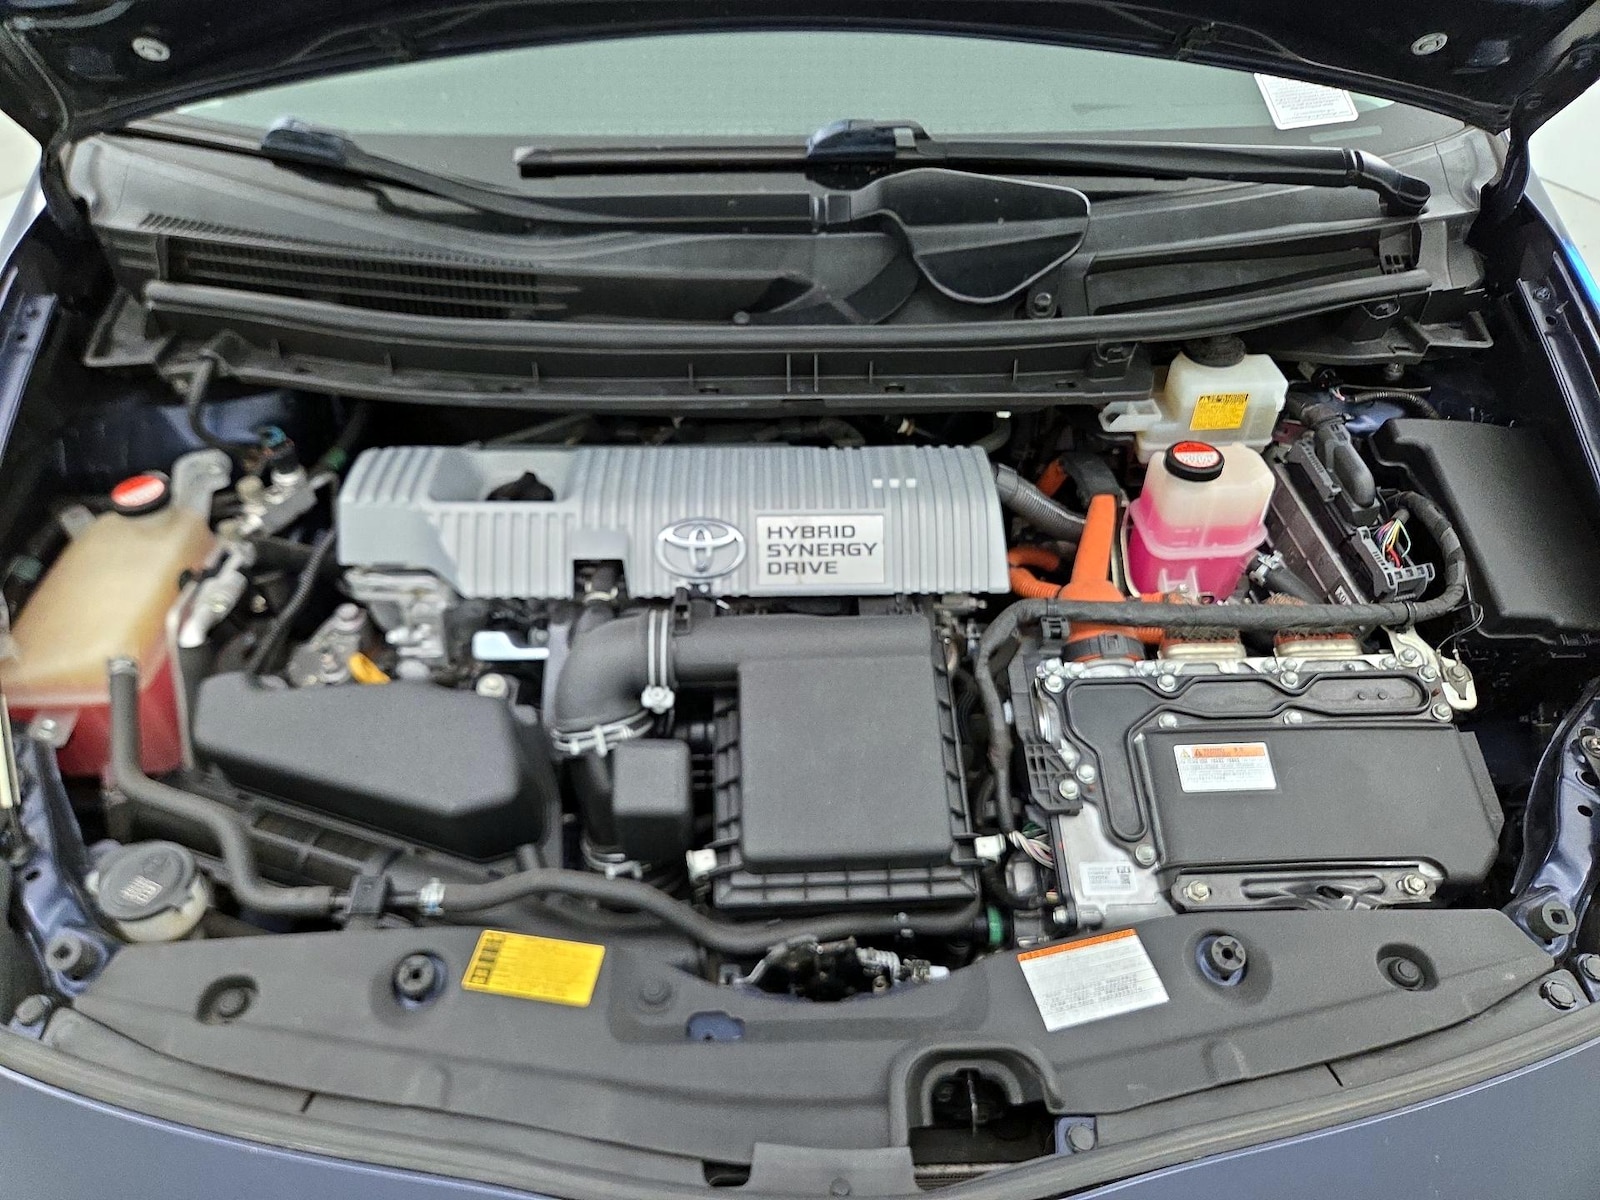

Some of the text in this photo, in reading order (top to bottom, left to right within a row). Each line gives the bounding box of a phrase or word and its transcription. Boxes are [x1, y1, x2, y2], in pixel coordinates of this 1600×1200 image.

[768, 525, 856, 539] HYBRID
[768, 543, 877, 557] SYNERGY
[768, 562, 837, 575] DRIVE
